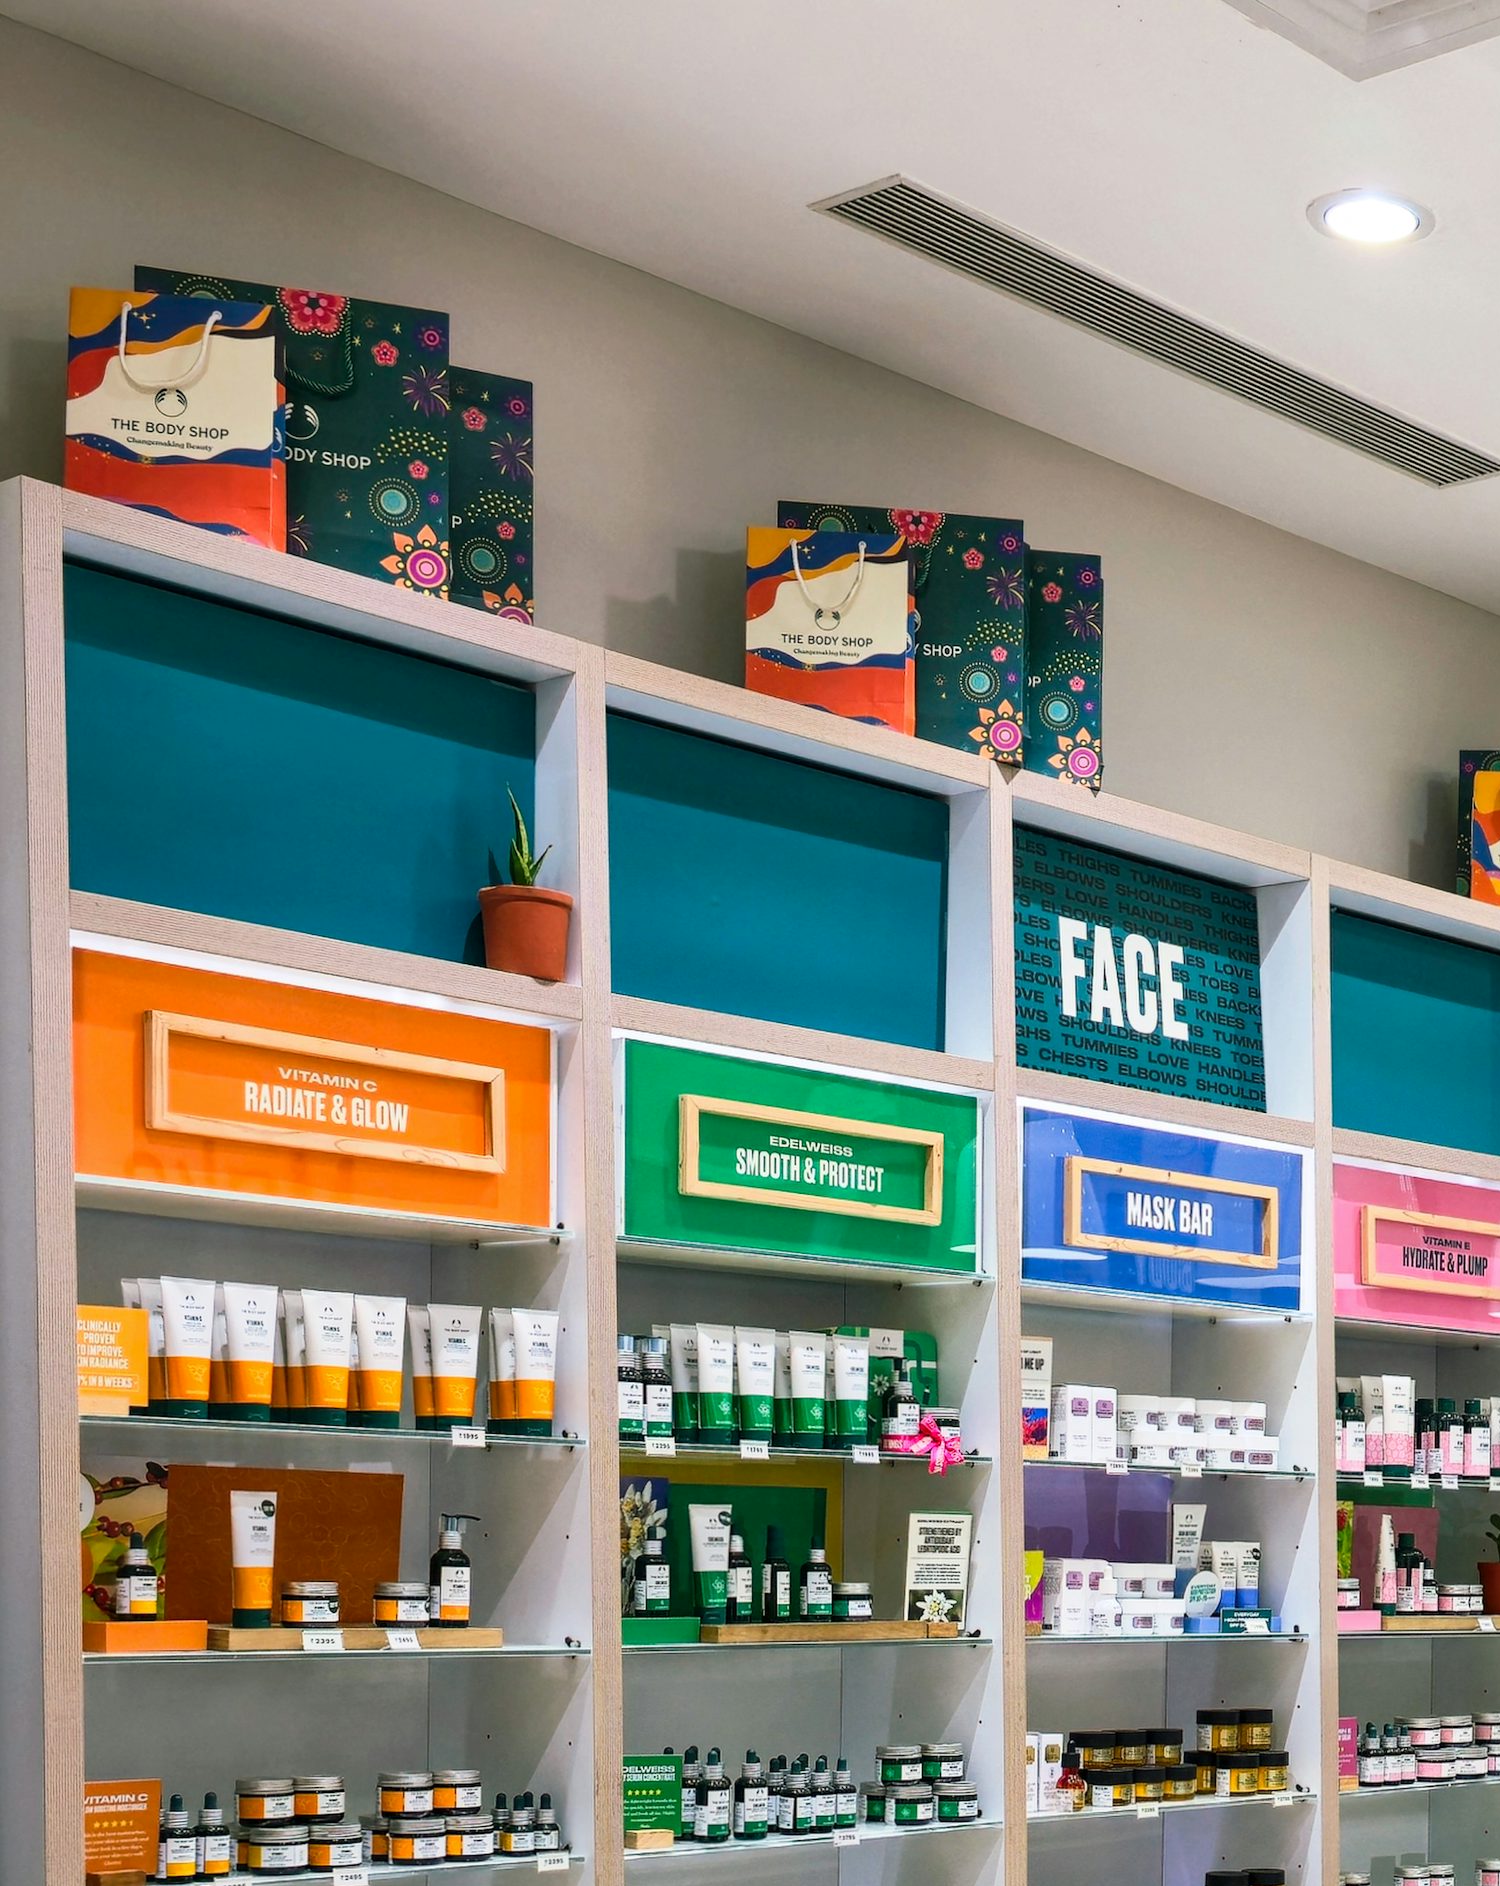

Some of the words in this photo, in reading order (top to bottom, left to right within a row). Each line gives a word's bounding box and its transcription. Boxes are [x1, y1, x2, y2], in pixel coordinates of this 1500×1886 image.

[111, 418, 140, 432] THE
[145, 421, 185, 437] BODY
[189, 424, 229, 440] SHOP
[126, 435, 184, 450] Changemaking
[186, 443, 214, 452] Beauty
[322, 452, 371, 469] SHOP
[781, 633, 803, 644] THE
[808, 635, 839, 646] BODY
[842, 636, 873, 647] SHOP
[1034, 862, 1106, 890] ELBOWS
[1115, 884, 1212, 919] SHOULDERS
[1058, 916, 1189, 1041] FACE
[1039, 1045, 1108, 1072] CHESTS
[1118, 1064, 1187, 1087] ELBOWS
[278, 1067, 359, 1090] VITAMIN
[364, 1080, 377, 1093] C
[245, 1082, 326, 1123] RADIATE
[331, 1098, 347, 1125] &
[351, 1099, 409, 1133] GLOW
[769, 1136, 853, 1157] EDELWEISS
[736, 1148, 799, 1181] SMOOTH
[804, 1158, 816, 1183] &
[819, 1160, 884, 1192] PROTECT
[1127, 1192, 1174, 1231] MASK
[1179, 1199, 1213, 1236] BAR
[1423, 1235, 1461, 1249] VITAMIN
[1463, 1241, 1471, 1250] E
[1402, 1245, 1445, 1272] HYDRATE
[1447, 1251, 1456, 1273] &
[1457, 1252, 1488, 1277] PLUMP
[84, 1333, 115, 1344] PROVEN
